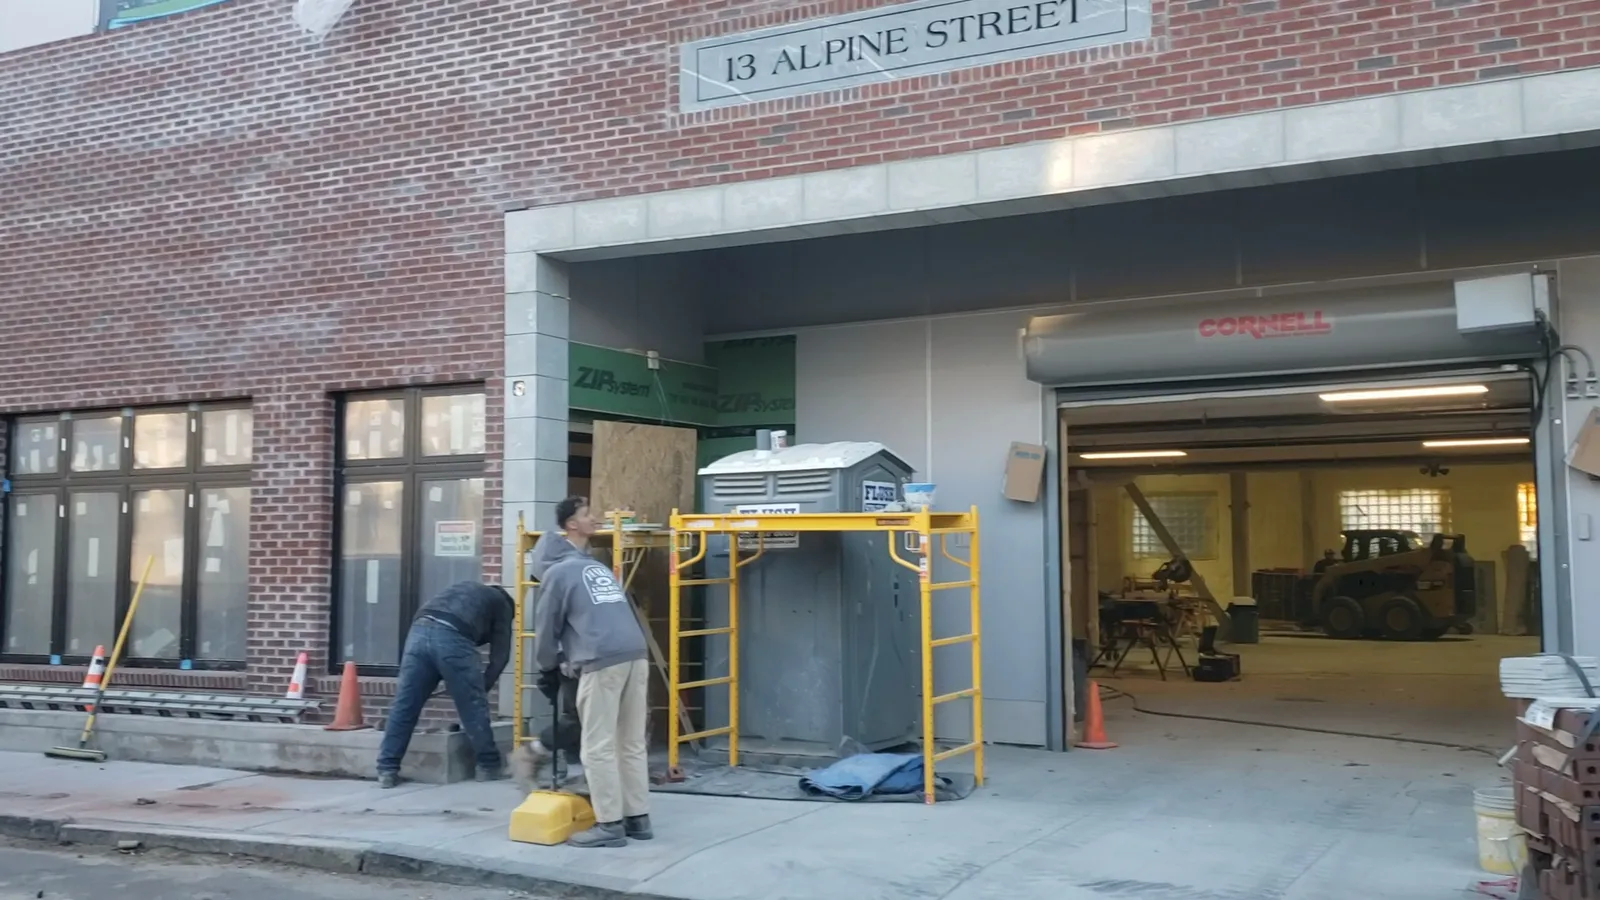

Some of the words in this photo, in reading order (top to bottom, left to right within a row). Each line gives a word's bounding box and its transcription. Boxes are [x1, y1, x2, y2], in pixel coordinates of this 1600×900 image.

[726, 53, 757, 82] 13
[771, 27, 909, 75] ALPINE
[925, 0, 1090, 49] STREET
[1199, 310, 1332, 339] CORNELL
[573, 366, 614, 391] ZIP
